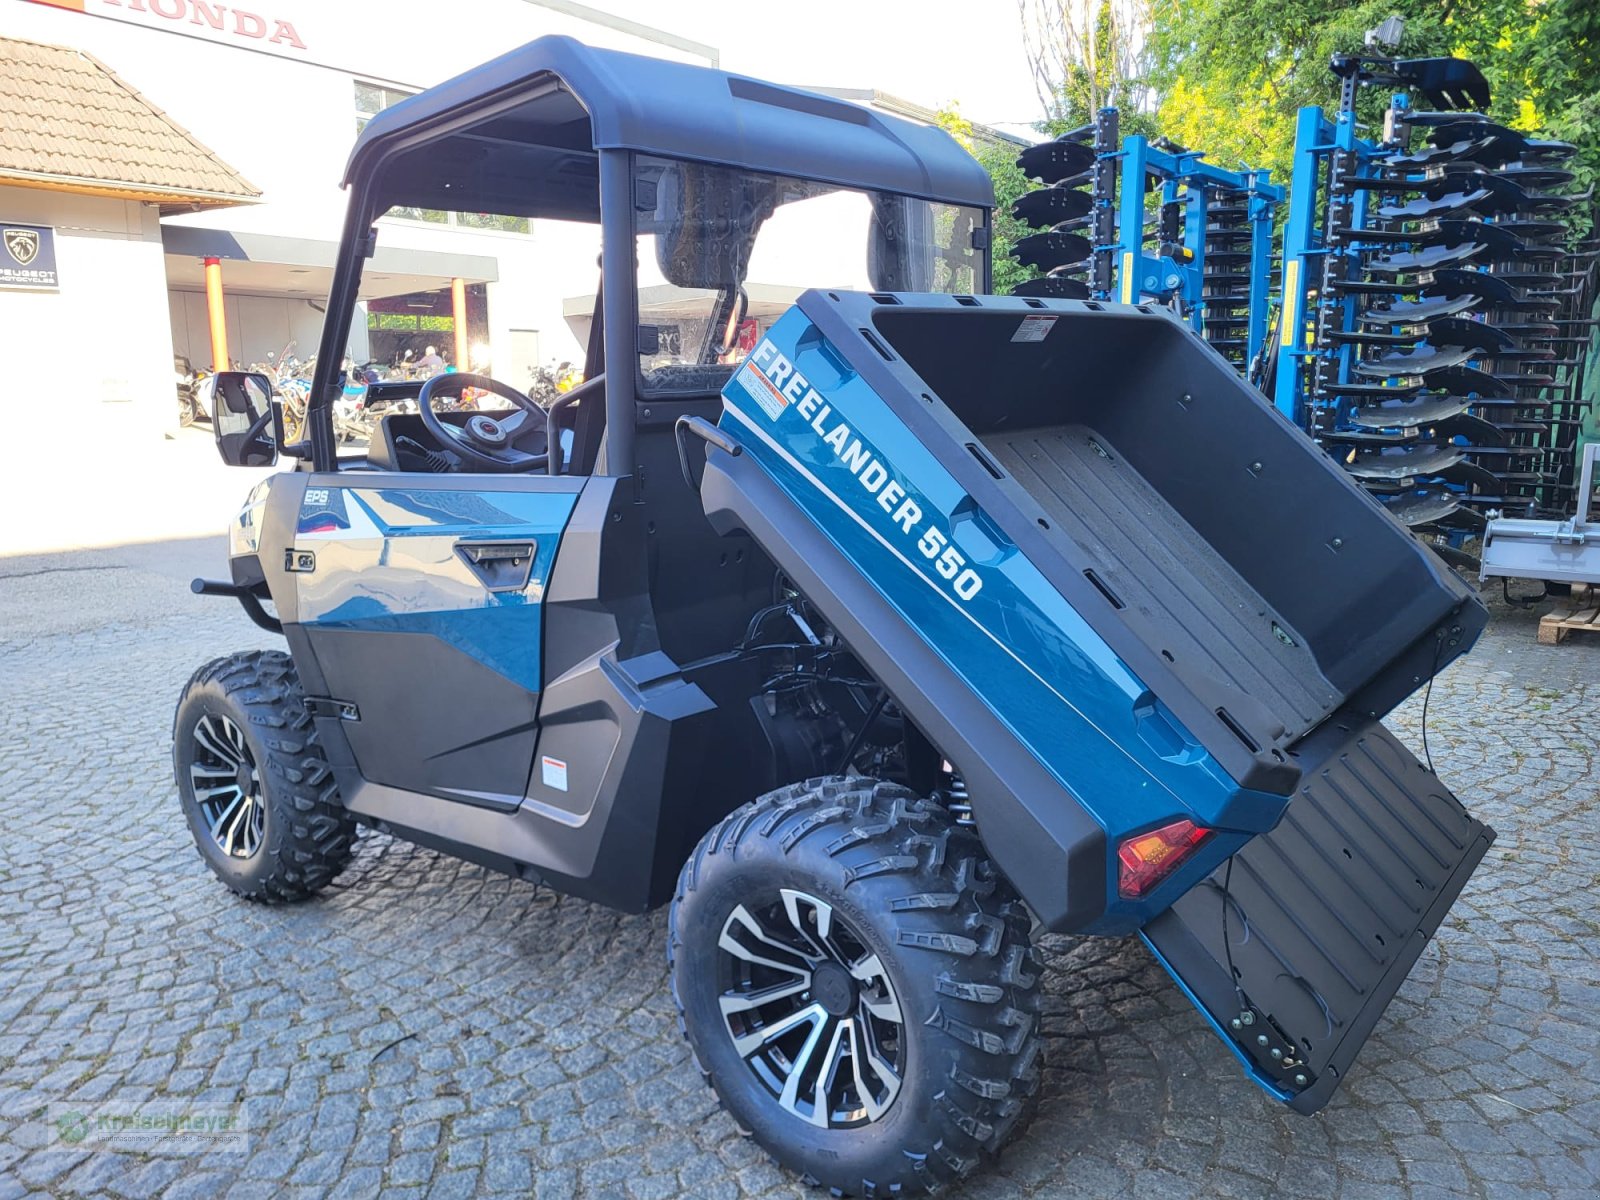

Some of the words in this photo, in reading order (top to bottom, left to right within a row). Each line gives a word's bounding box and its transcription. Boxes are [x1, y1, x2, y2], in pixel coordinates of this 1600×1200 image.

[304, 490, 329, 503] EPS
[751, 338, 922, 535] FREELANDER
[917, 525, 983, 600] 550
